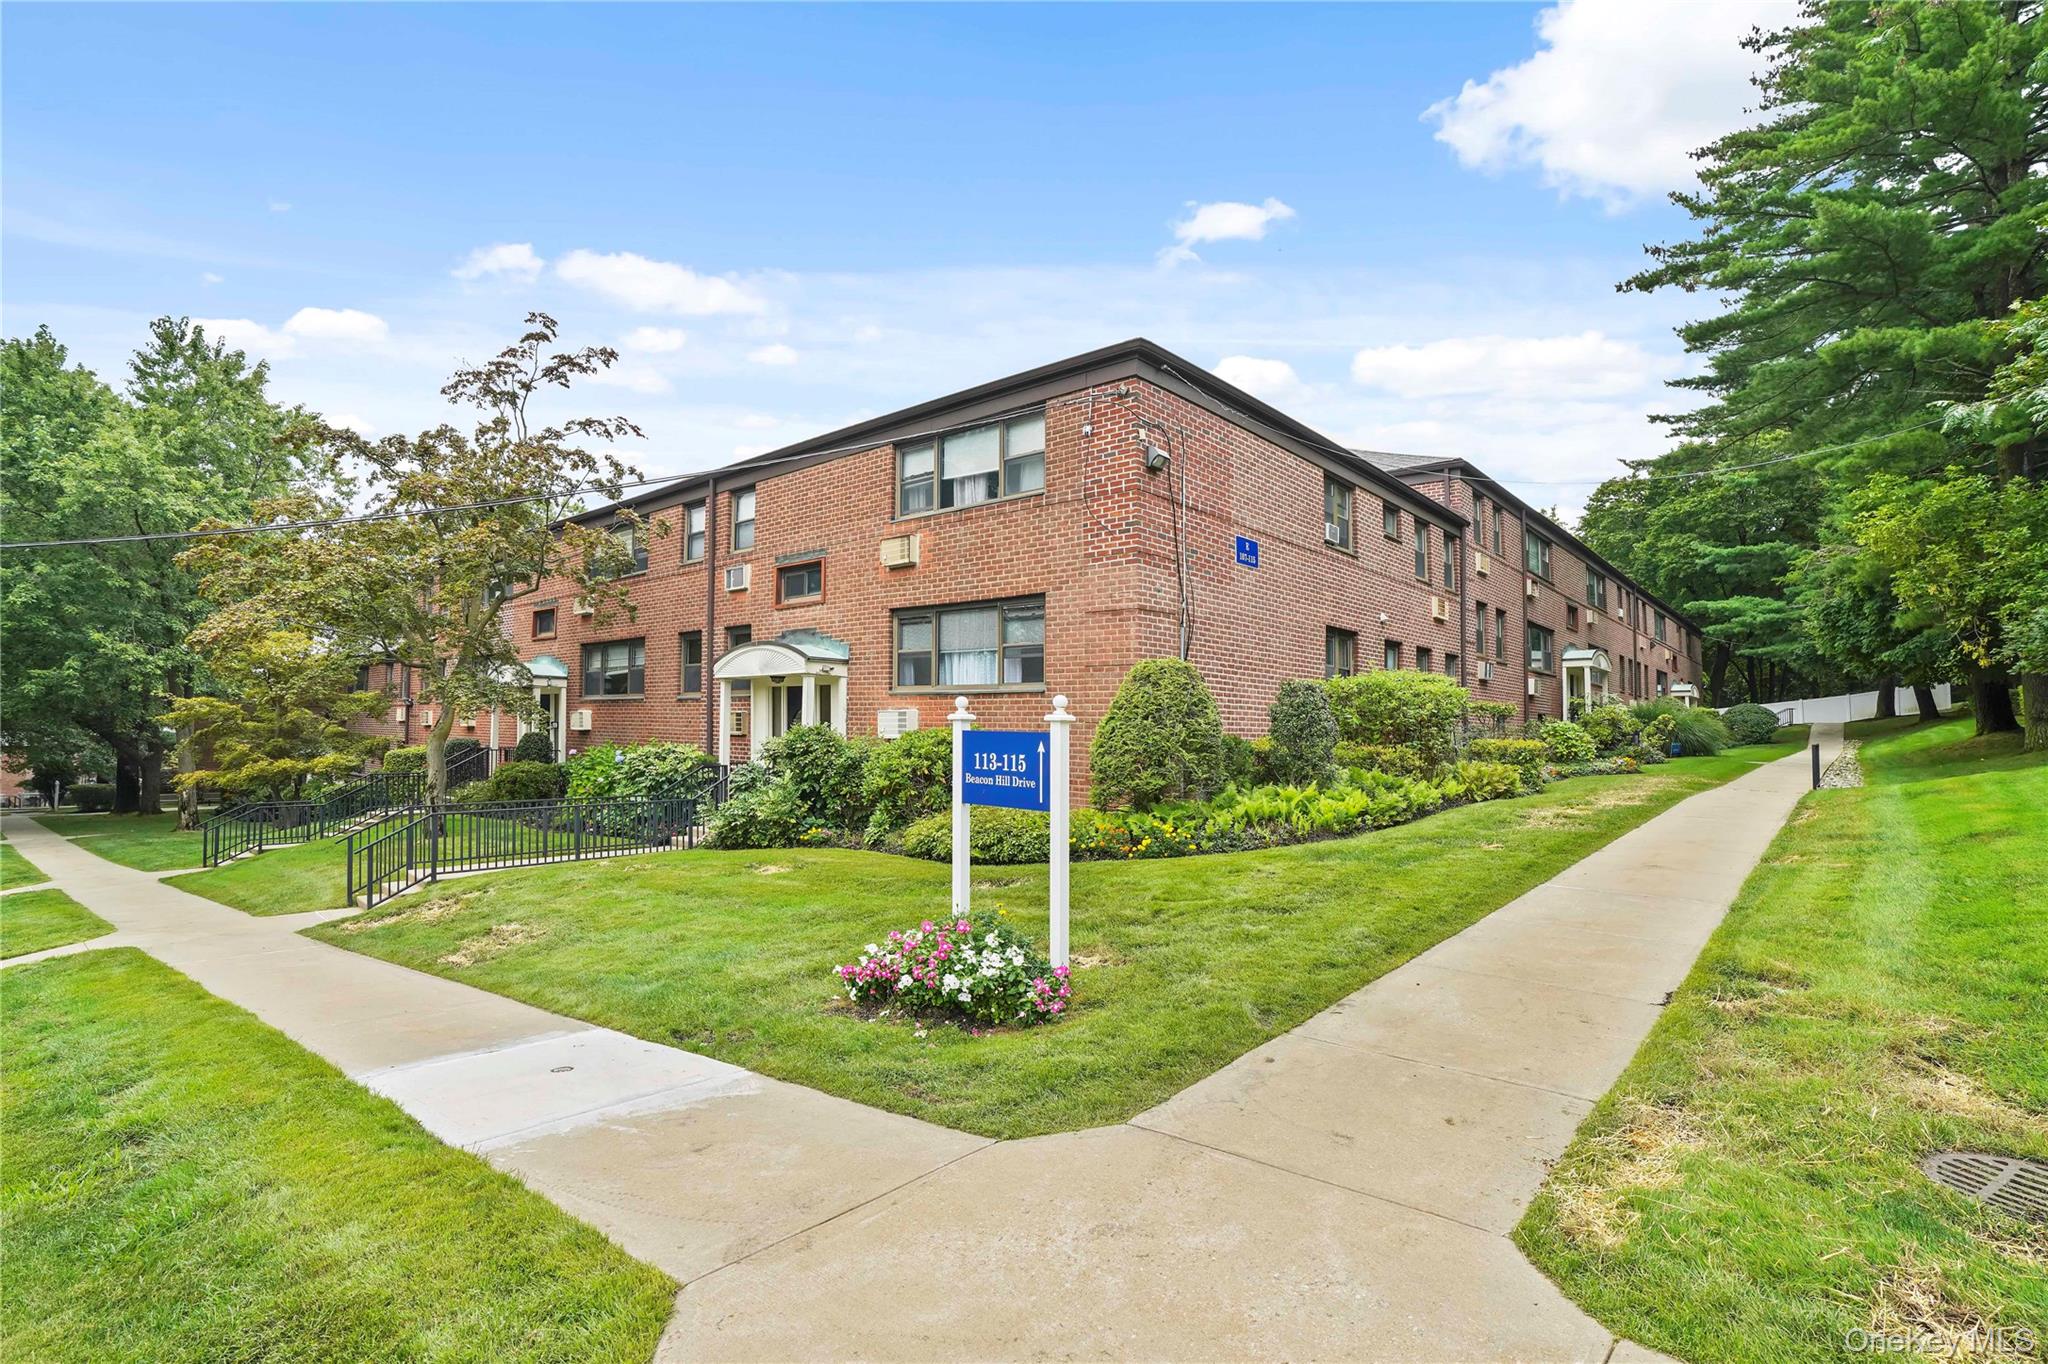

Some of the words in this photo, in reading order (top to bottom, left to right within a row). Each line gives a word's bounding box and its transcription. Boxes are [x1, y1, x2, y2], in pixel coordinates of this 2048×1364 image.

[974, 752, 1026, 772] 113-115
[965, 773, 993, 785] Beacon
[995, 774, 1011, 787] Hill
[1012, 775, 1036, 789] Drive
